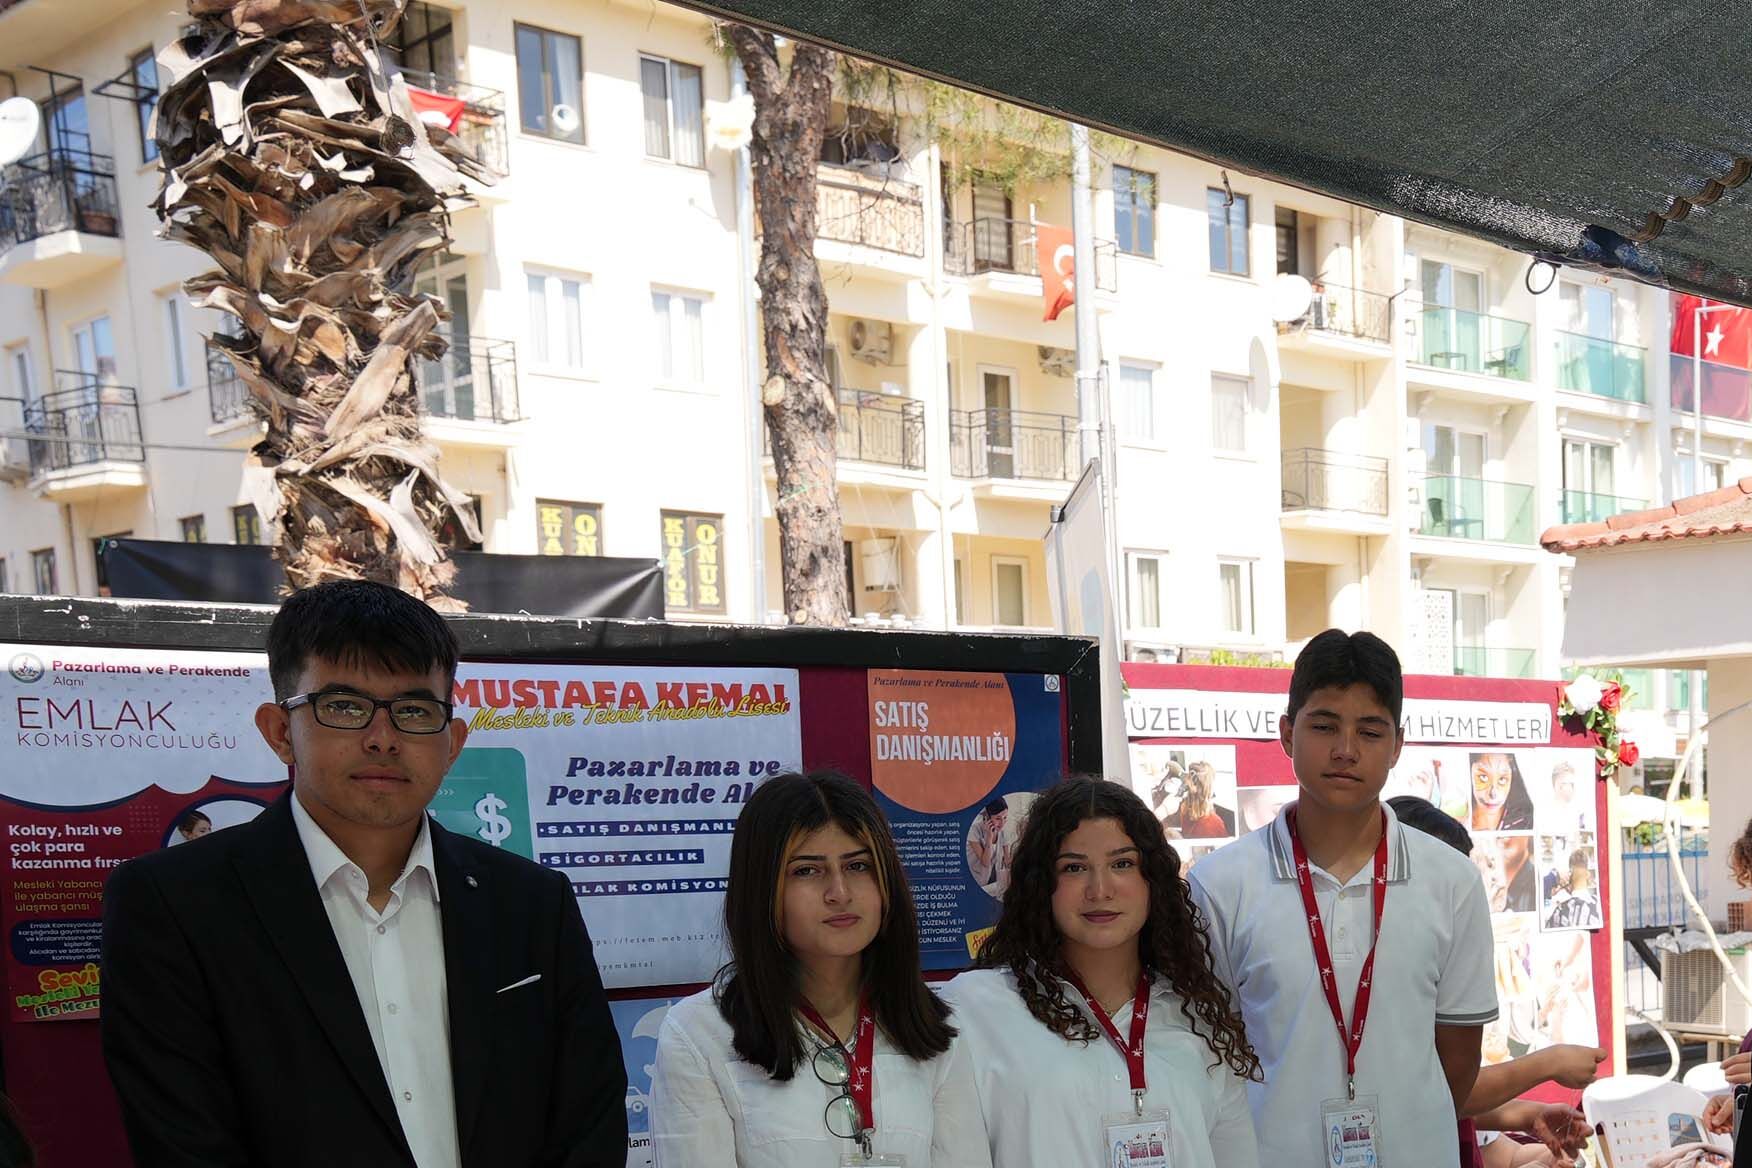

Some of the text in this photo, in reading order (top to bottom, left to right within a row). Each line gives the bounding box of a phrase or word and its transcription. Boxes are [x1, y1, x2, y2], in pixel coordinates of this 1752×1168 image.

[696, 524, 720, 605] ONUR
[52, 660, 250, 677] Pazarlama ve Perakende
[53, 676, 84, 686] Alanı
[874, 677, 921, 688] Pazarlama
[923, 679, 934, 687] ve
[935, 679, 981, 688] Perakende
[452, 679, 649, 711] MUSTAFA
[17, 697, 176, 731] EMLAK
[468, 696, 790, 734] Mesleki ve Teknik Anadolu Lisesi
[874, 700, 929, 733] SATIŞ
[1123, 706, 1241, 734] ÜZELLİK
[1247, 708, 1277, 734] VE
[17, 731, 237, 750] KOMİSYONCULUĞU
[876, 732, 1010, 765] DANIŞMANLIĞI
[565, 755, 781, 778] Pazarlama ve
[546, 783, 715, 807] Perakende
[8, 824, 123, 839] Kolay, hızlı ve
[547, 824, 610, 836] SATIŞ
[10, 841, 85, 856] çok para
[550, 852, 699, 865] SİGORTACILIK
[12, 856, 129, 869] kazanma fırs
